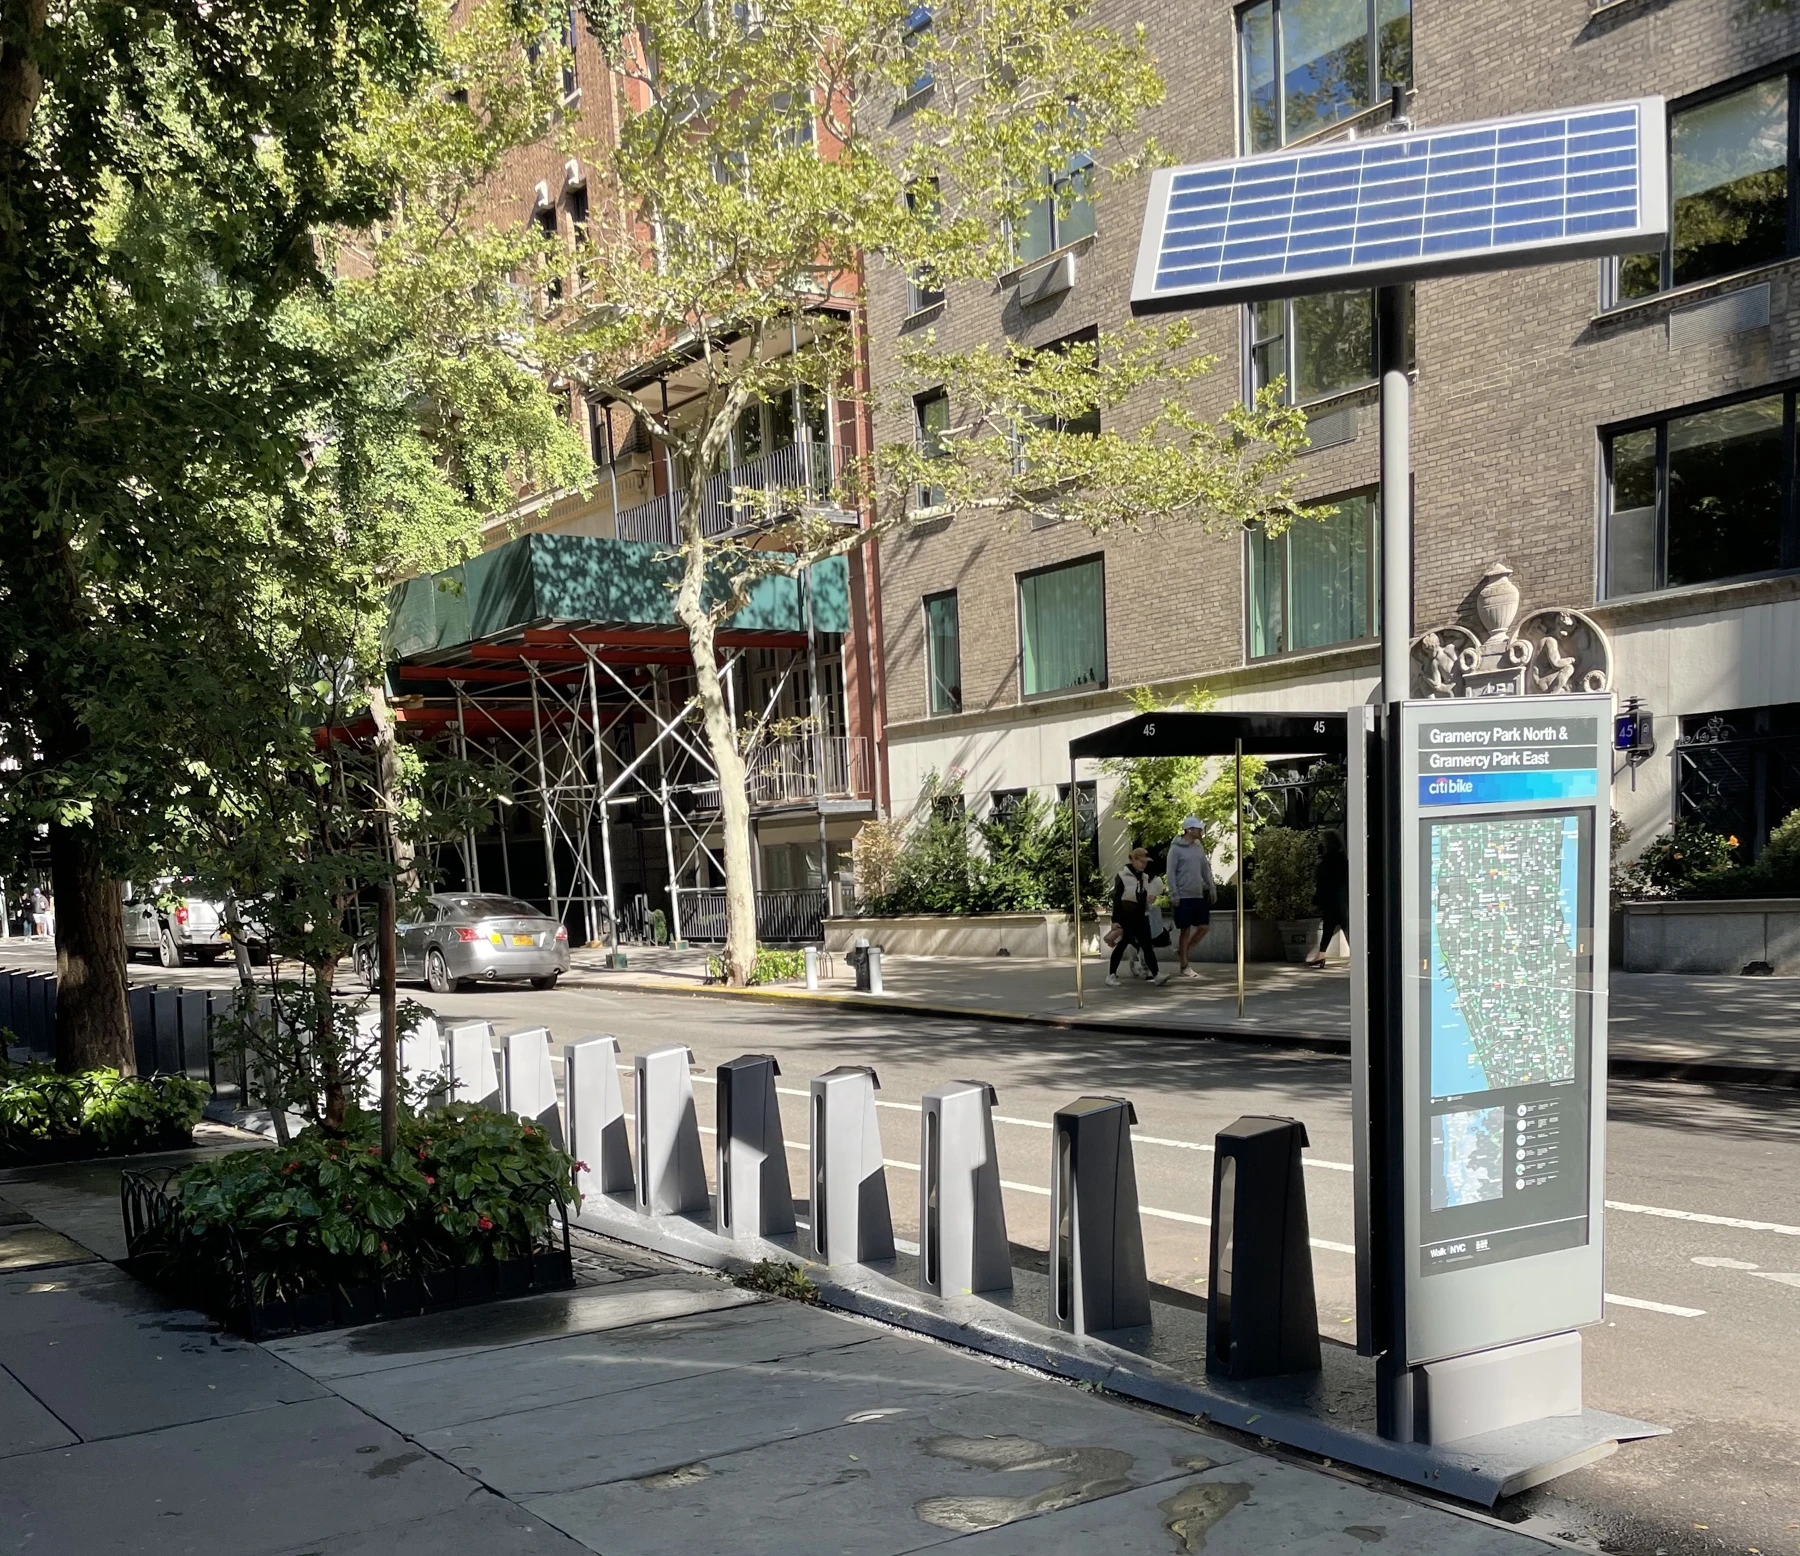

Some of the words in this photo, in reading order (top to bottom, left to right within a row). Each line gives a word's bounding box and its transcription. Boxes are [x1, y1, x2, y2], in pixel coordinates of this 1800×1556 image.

[1143, 723, 1156, 736] 45
[1313, 720, 1326, 733] 45
[1619, 724, 1633, 738] 45
[1430, 728, 1491, 745] Gramercy
[1493, 727, 1521, 742] Park
[1523, 726, 1556, 741] North
[1558, 726, 1569, 740] &
[1429, 753, 1490, 769] Gramercy
[1492, 751, 1520, 766] Park
[1523, 751, 1550, 765] East
